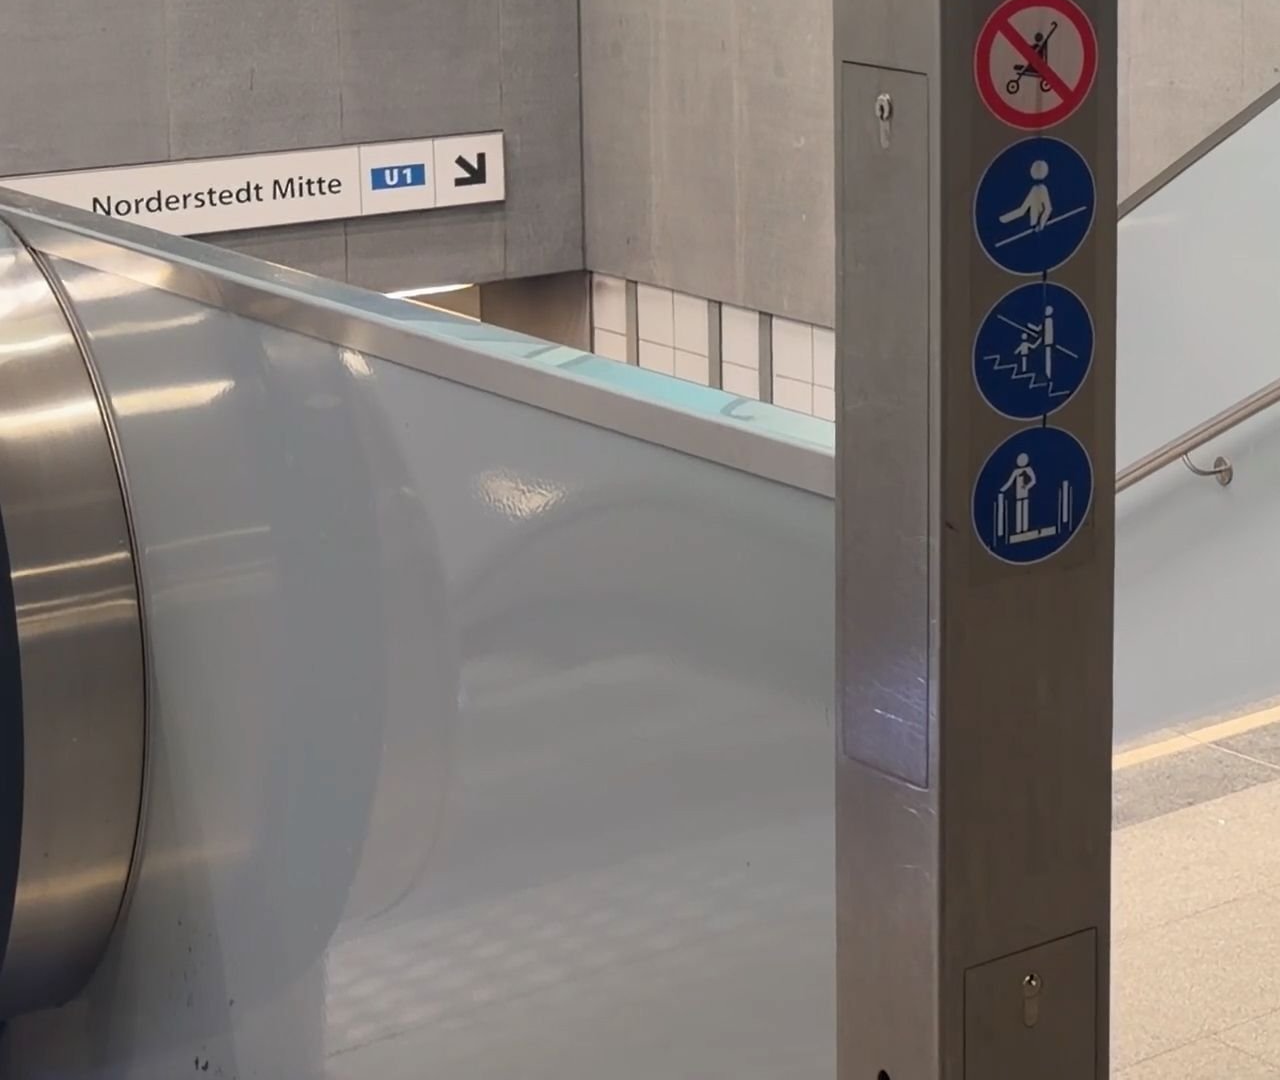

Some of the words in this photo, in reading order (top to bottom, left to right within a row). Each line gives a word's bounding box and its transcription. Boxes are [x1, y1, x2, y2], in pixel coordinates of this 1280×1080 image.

[92, 180, 264, 217] Norderstedt
[272, 174, 342, 201] Mitte
[384, 167, 413, 185] U1
